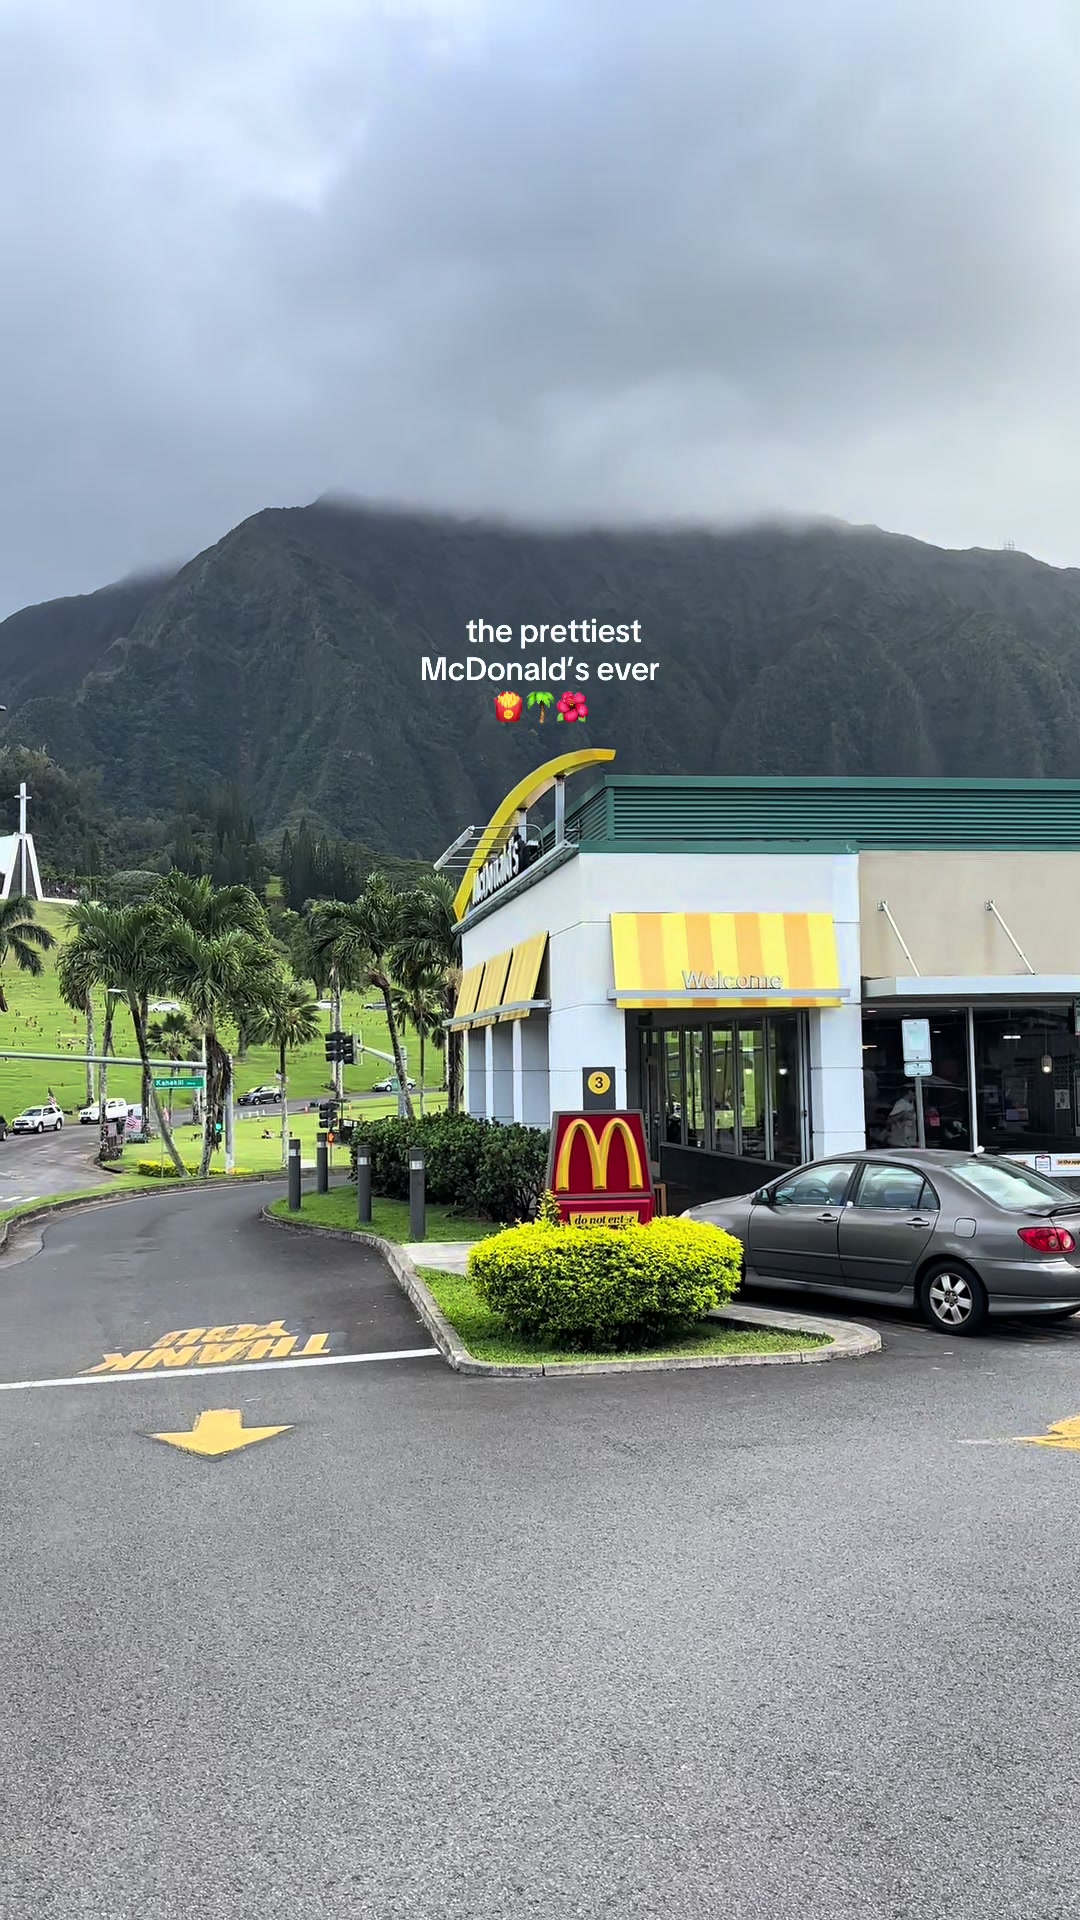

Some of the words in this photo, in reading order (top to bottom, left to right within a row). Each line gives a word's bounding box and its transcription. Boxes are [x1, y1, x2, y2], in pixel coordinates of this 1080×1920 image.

[682, 970, 783, 990] Welcome
[594, 1076, 604, 1089] 3
[574, 1214, 588, 1225] do
[589, 1216, 606, 1225] not
[150, 1319, 291, 1349] YOU
[77, 1333, 331, 1375] THANK
